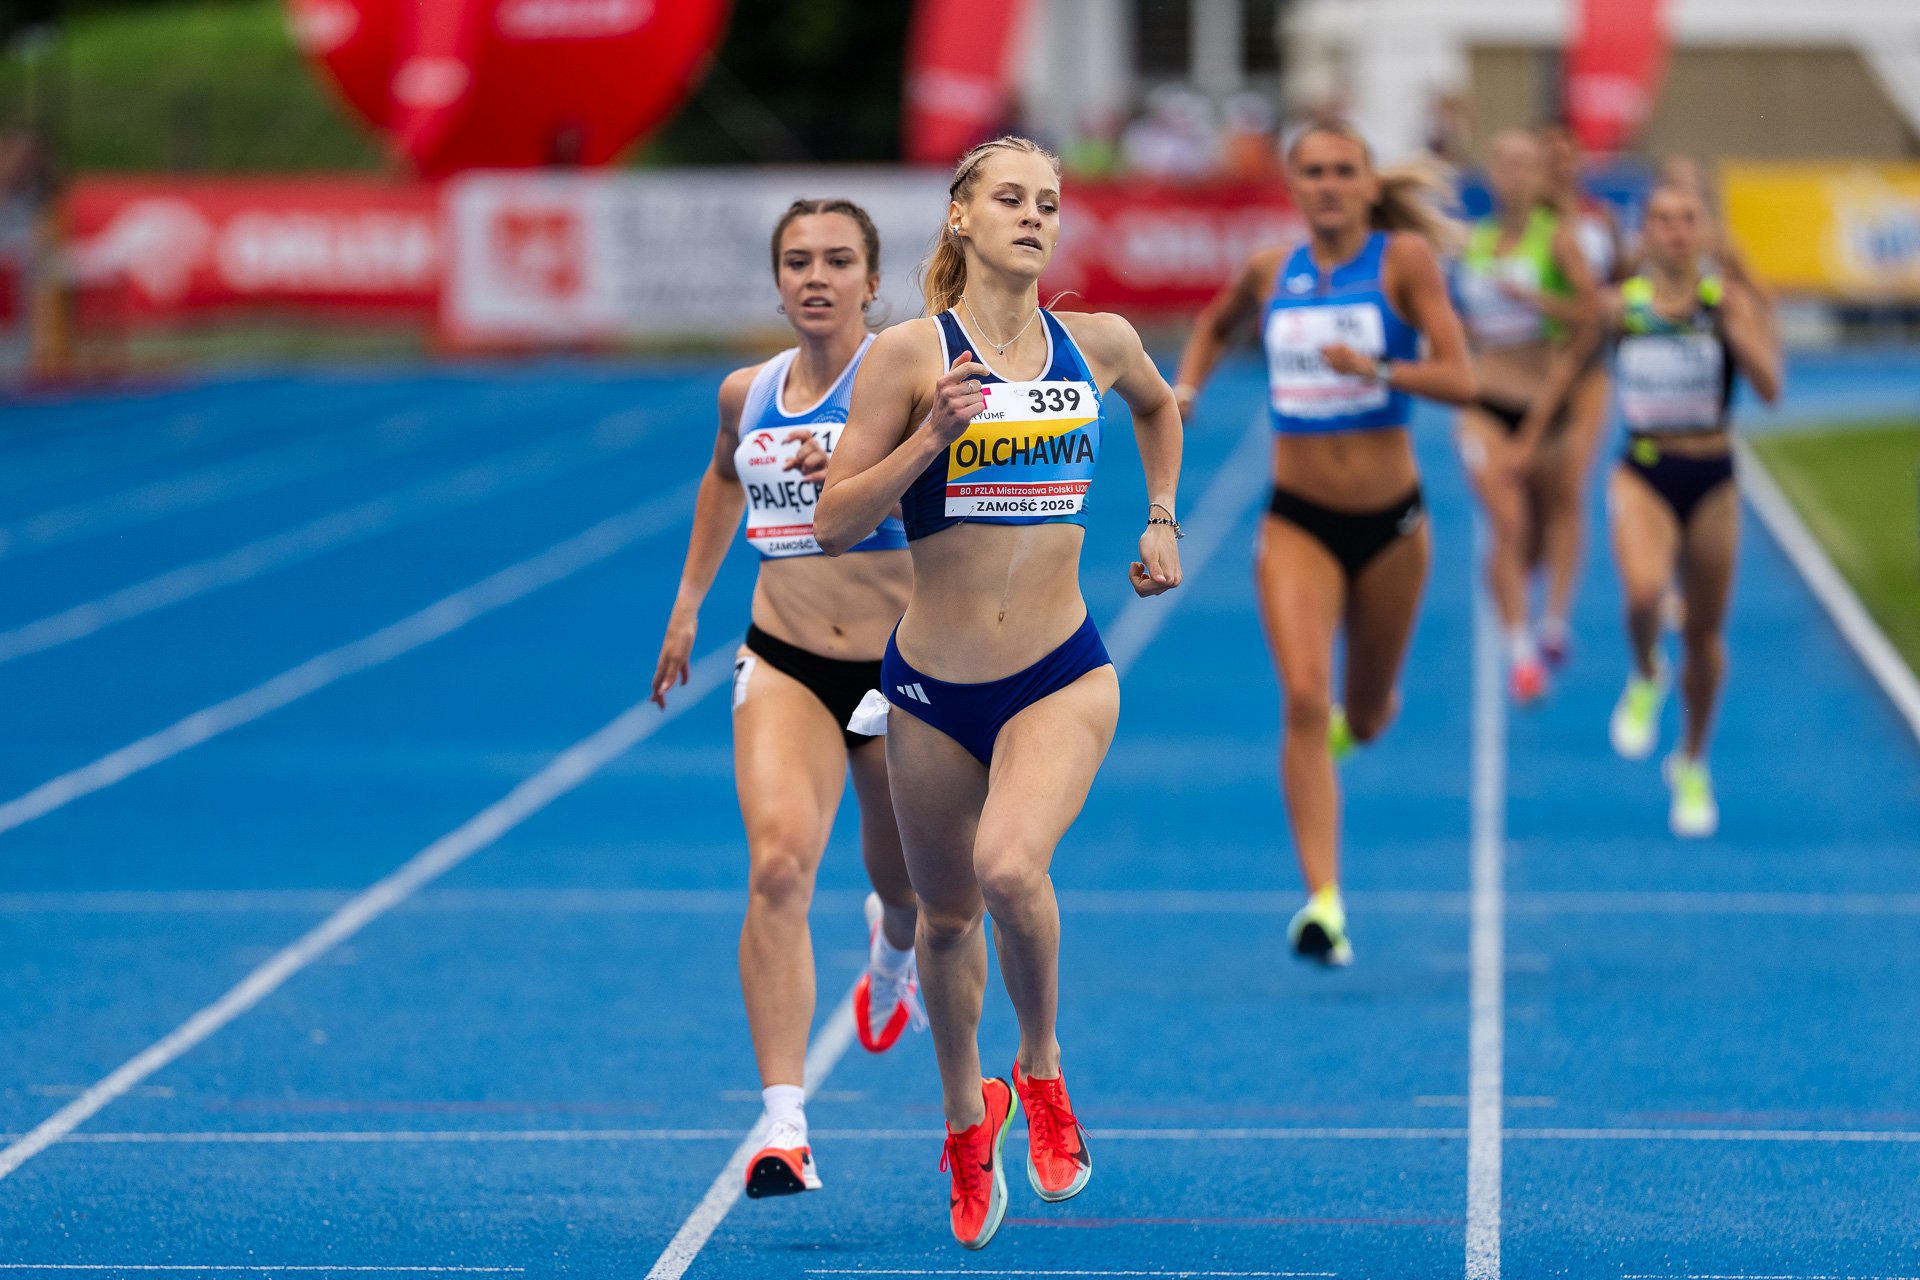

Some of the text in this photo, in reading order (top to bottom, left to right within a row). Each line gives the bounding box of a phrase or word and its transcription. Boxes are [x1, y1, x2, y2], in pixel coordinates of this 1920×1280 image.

[1028, 387, 1081, 413] 339
[956, 434, 1095, 468] OLCHAWA
[749, 456, 776, 466] ORLEN
[960, 487, 973, 496] 80.
[974, 486, 995, 496] PZLA
[996, 485, 1047, 495] Mistrzostwa
[1048, 484, 1073, 494] Polski
[977, 498, 1075, 512] ZAMOŚĆ 2026
